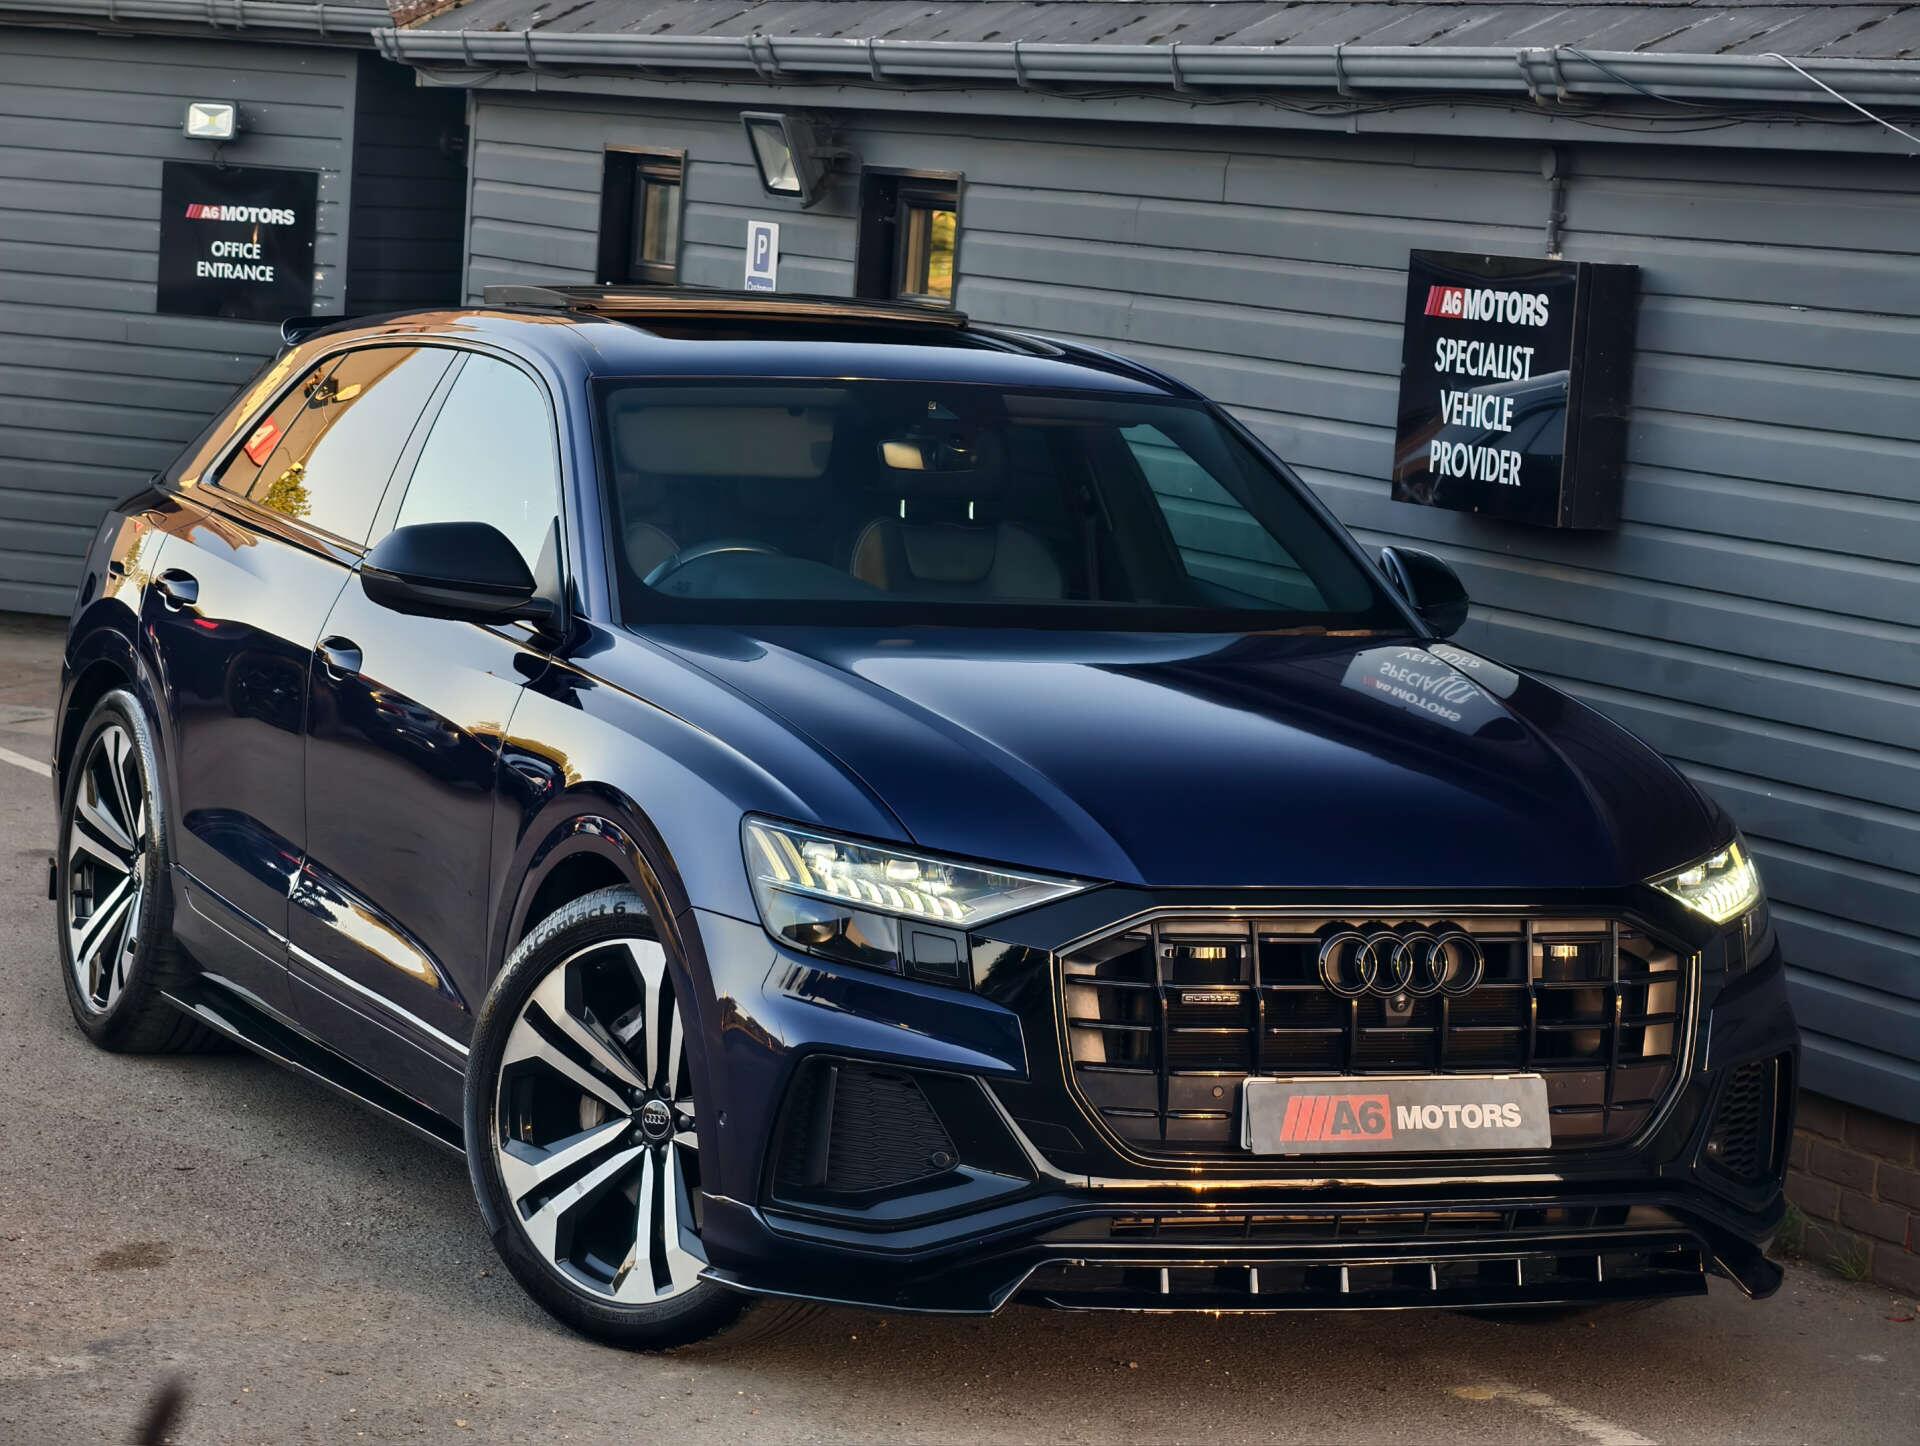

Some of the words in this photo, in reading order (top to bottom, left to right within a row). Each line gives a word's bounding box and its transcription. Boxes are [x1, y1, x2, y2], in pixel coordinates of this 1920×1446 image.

[211, 241, 261, 260] OFFICE
[756, 234, 768, 264] P
[196, 261, 274, 282] ENTRANCE
[1462, 288, 1549, 327] MOTORS
[1434, 337, 1535, 382] SPECIALIST
[1440, 389, 1514, 432] VEHICLE
[1429, 439, 1522, 486] PROVIDER
[1331, 1101, 1386, 1135] A6
[1396, 1103, 1522, 1130] MOTORS
